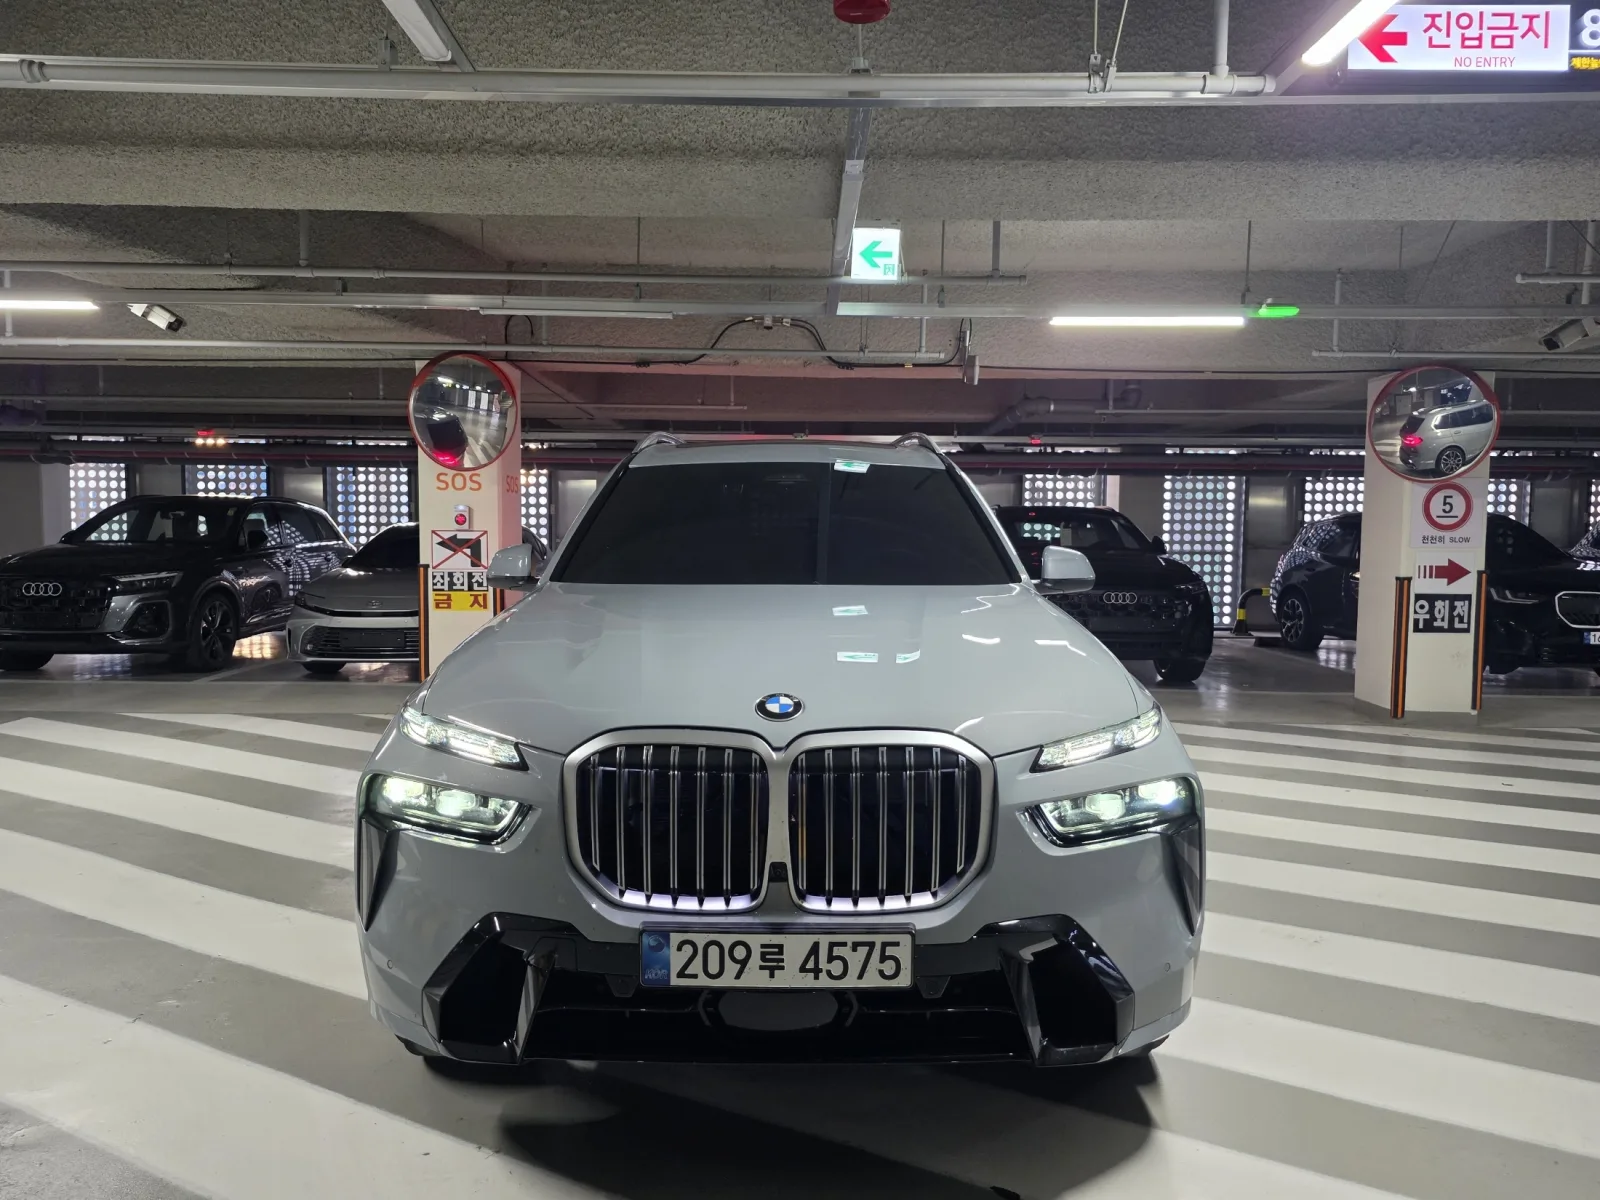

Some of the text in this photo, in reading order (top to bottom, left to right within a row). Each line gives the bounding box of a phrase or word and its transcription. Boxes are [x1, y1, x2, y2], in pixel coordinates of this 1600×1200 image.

[1422, 10, 1551, 49] 진입금지
[1454, 56, 1516, 68] NO ENTRY
[436, 472, 482, 492] SOS
[506, 475, 519, 494] SOS
[1442, 495, 1453, 513] 5
[1421, 534, 1471, 545] 천천히 SLOW
[432, 571, 488, 591] 좌회전
[1413, 600, 1469, 629] 우회전
[676, 939, 902, 981] 209루 4575
